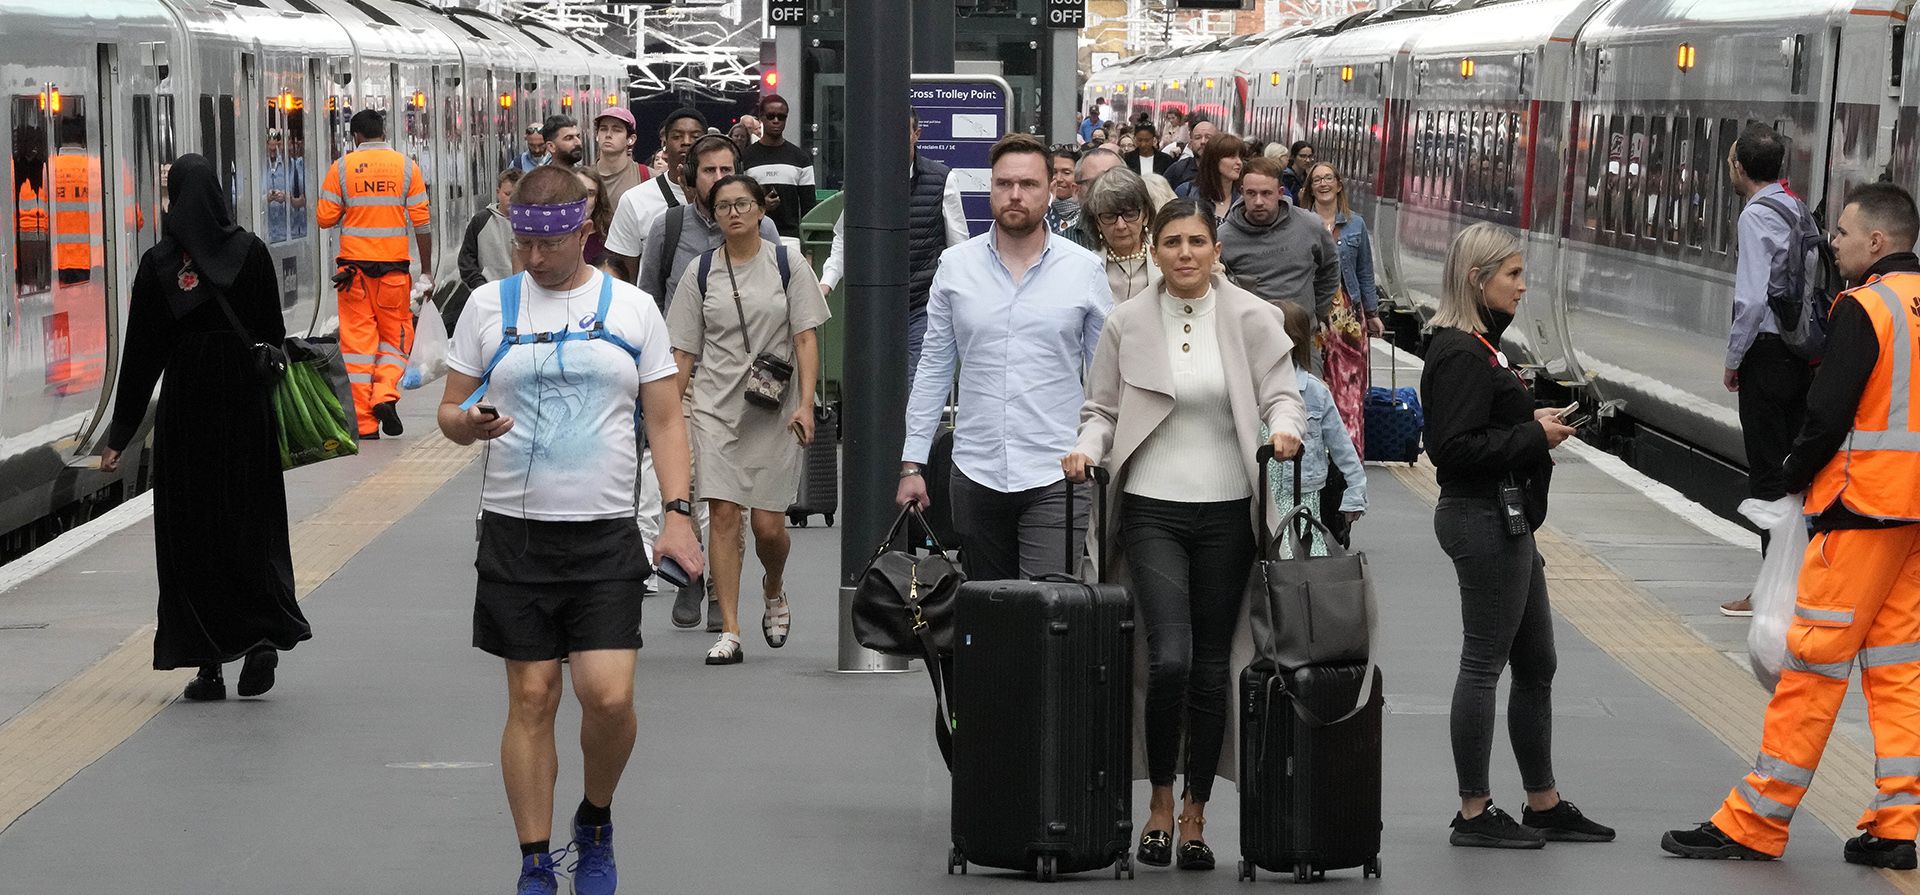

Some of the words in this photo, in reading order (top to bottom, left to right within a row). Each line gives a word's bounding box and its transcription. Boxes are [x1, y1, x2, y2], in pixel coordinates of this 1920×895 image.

[771, 7, 804, 21] OFF
[1050, 9, 1083, 23] OFF
[935, 89, 969, 101] Trolley
[970, 89, 997, 99] Point
[355, 180, 396, 193] LNER
